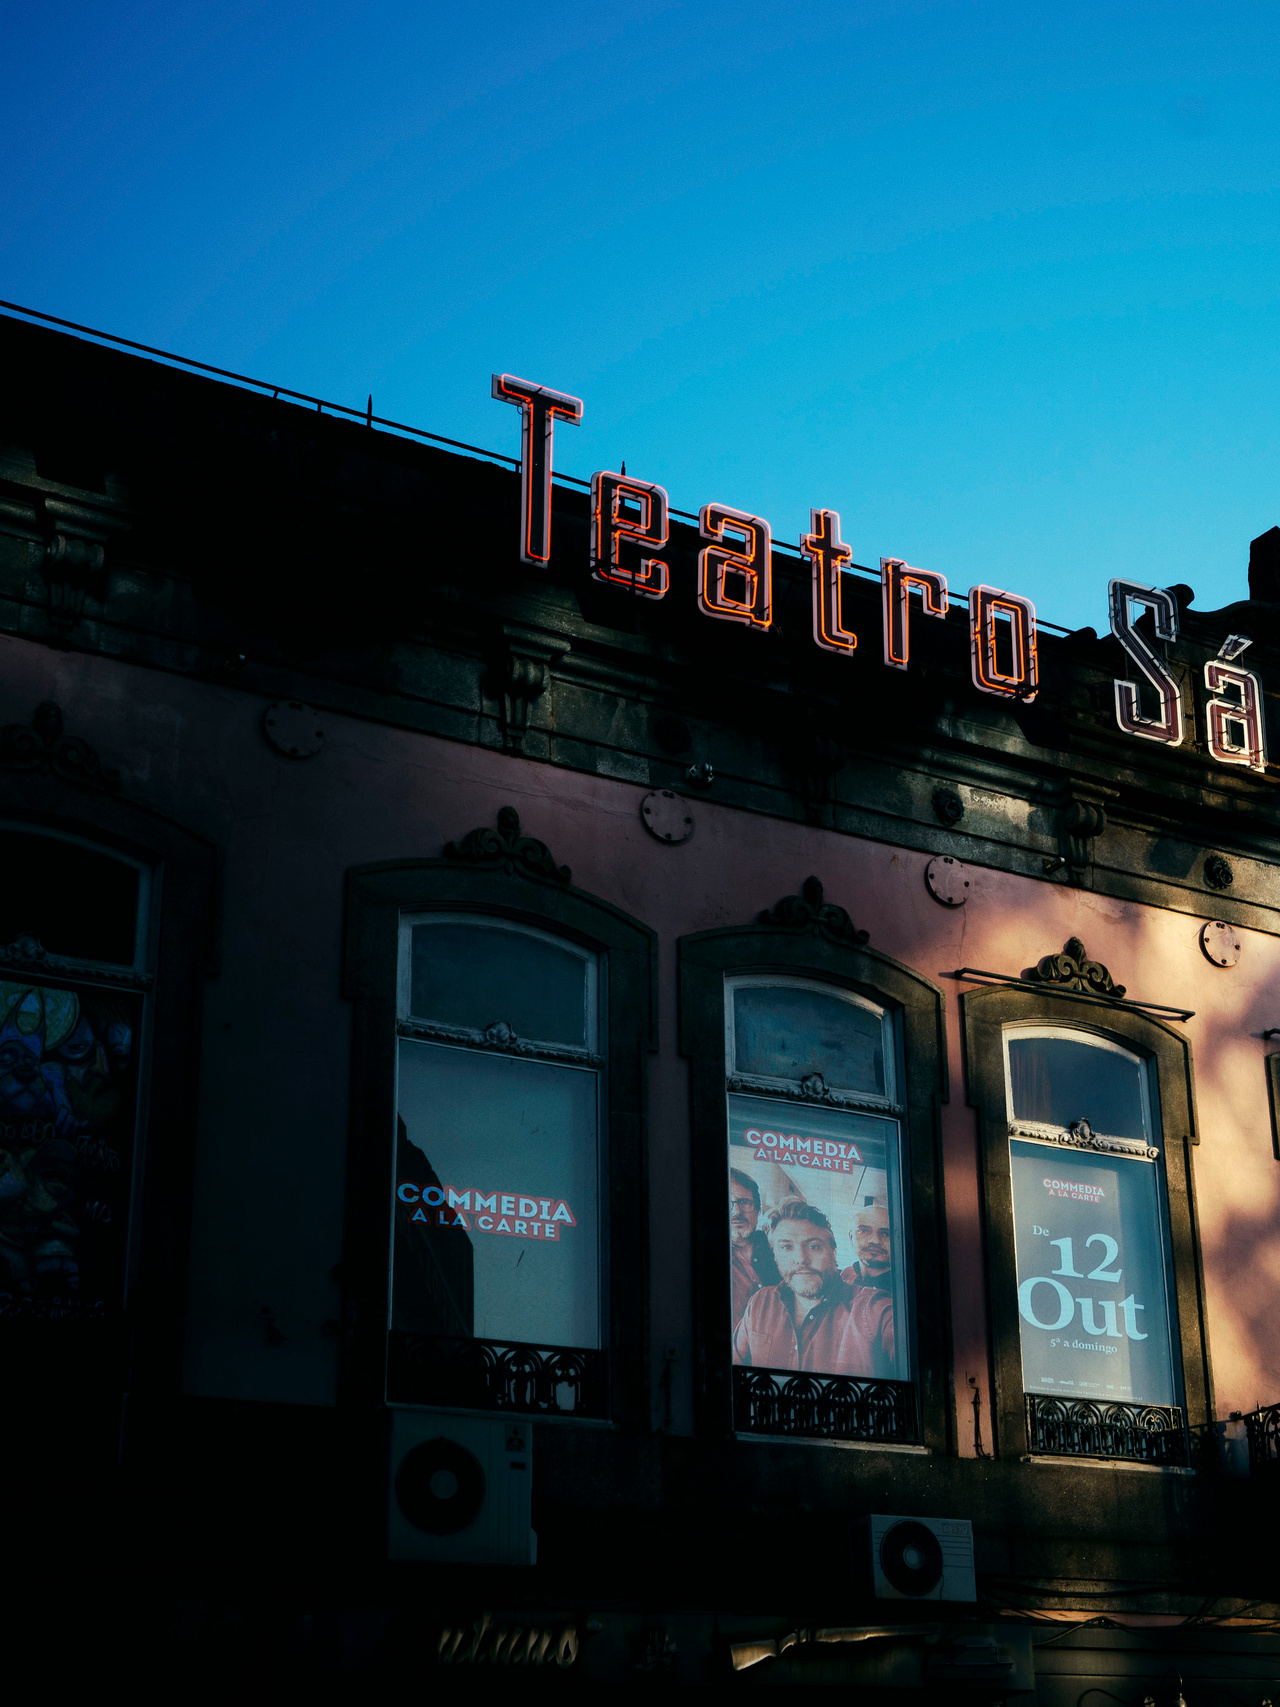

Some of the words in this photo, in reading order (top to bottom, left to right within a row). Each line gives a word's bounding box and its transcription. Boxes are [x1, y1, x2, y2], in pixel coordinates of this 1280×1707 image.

[491, 373, 1039, 703] Teatro
[1108, 577, 1268, 773] Sá
[744, 1130, 862, 1162] COMMEDIA
[756, 1148, 767, 1158] A
[774, 1152, 793, 1163] LA
[799, 1154, 850, 1171] CARTE
[1043, 1178, 1105, 1197] COMMEDIA
[1071, 1192, 1100, 1203] CARTE
[396, 1183, 573, 1224] COMMEDIA
[411, 1207, 428, 1222] A
[439, 1210, 468, 1228] LA
[477, 1215, 556, 1238] CARTE
[1032, 1224, 1050, 1237] De
[1050, 1233, 1123, 1283] 12
[1018, 1276, 1149, 1341] Out
[1063, 1340, 1070, 1348] a
[1072, 1339, 1118, 1354] domingo
